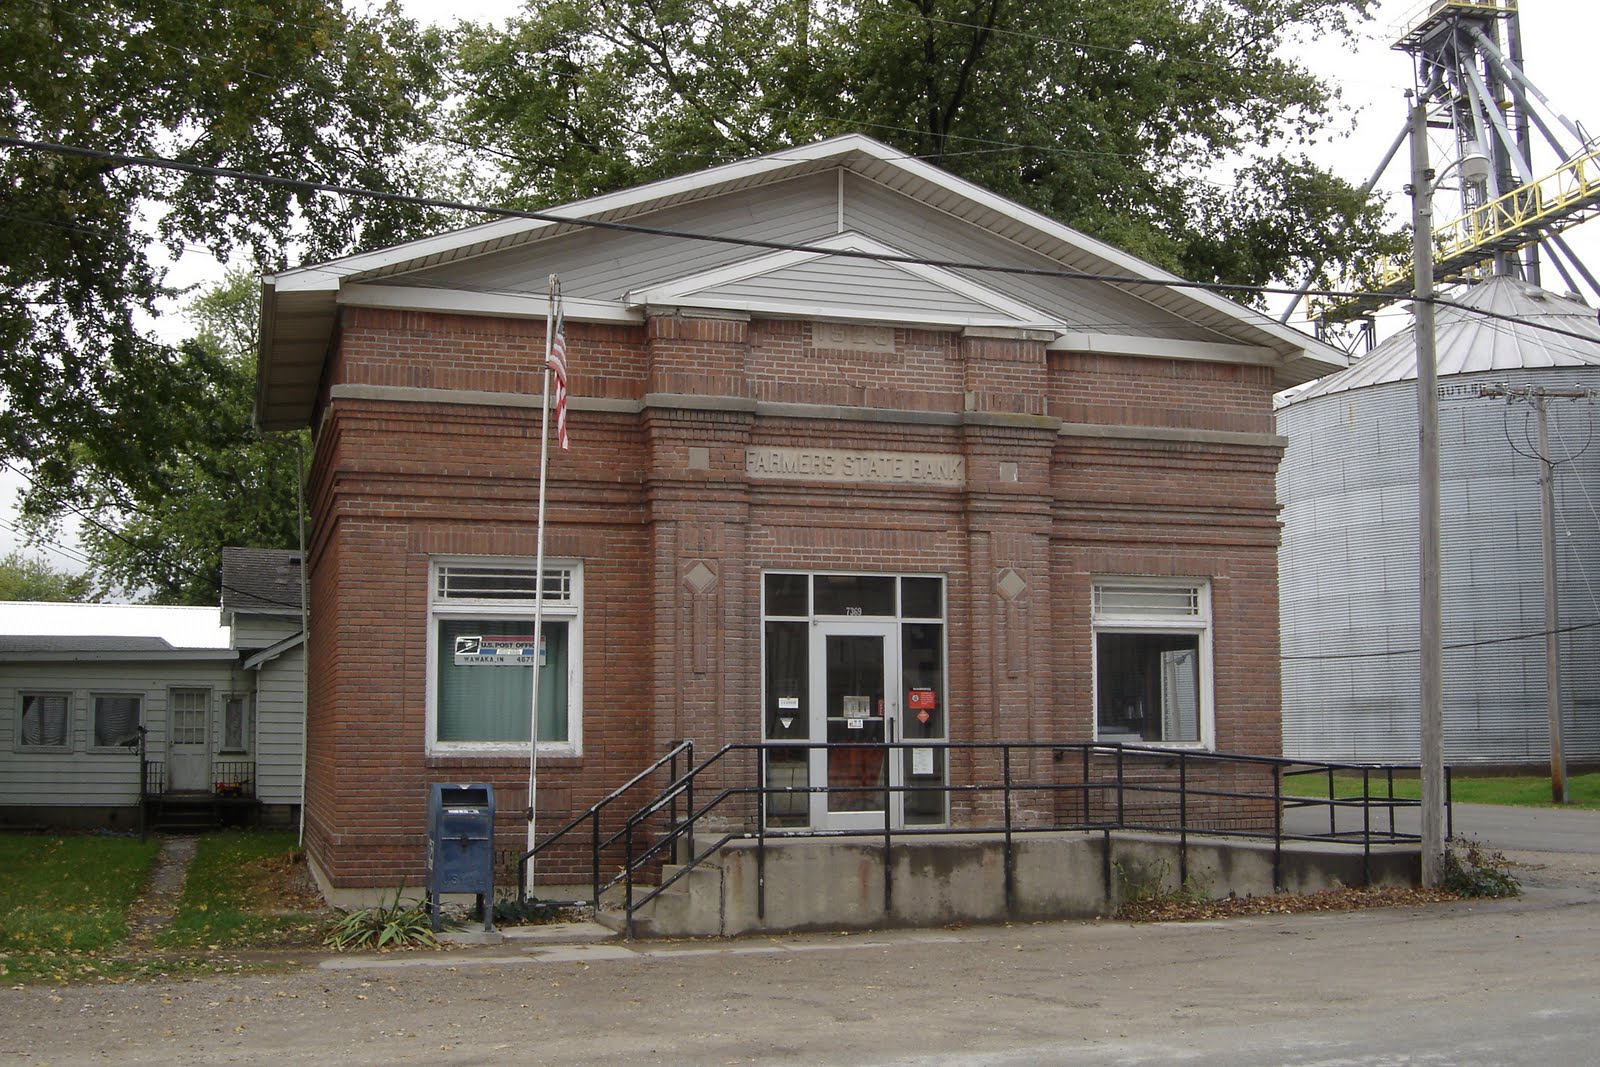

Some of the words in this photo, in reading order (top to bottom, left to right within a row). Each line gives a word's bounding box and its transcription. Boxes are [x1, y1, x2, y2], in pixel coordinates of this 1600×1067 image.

[746, 449, 835, 477] FARMERS
[843, 455, 905, 478] STATE
[910, 458, 963, 481] BANK
[846, 606, 862, 616] 7369
